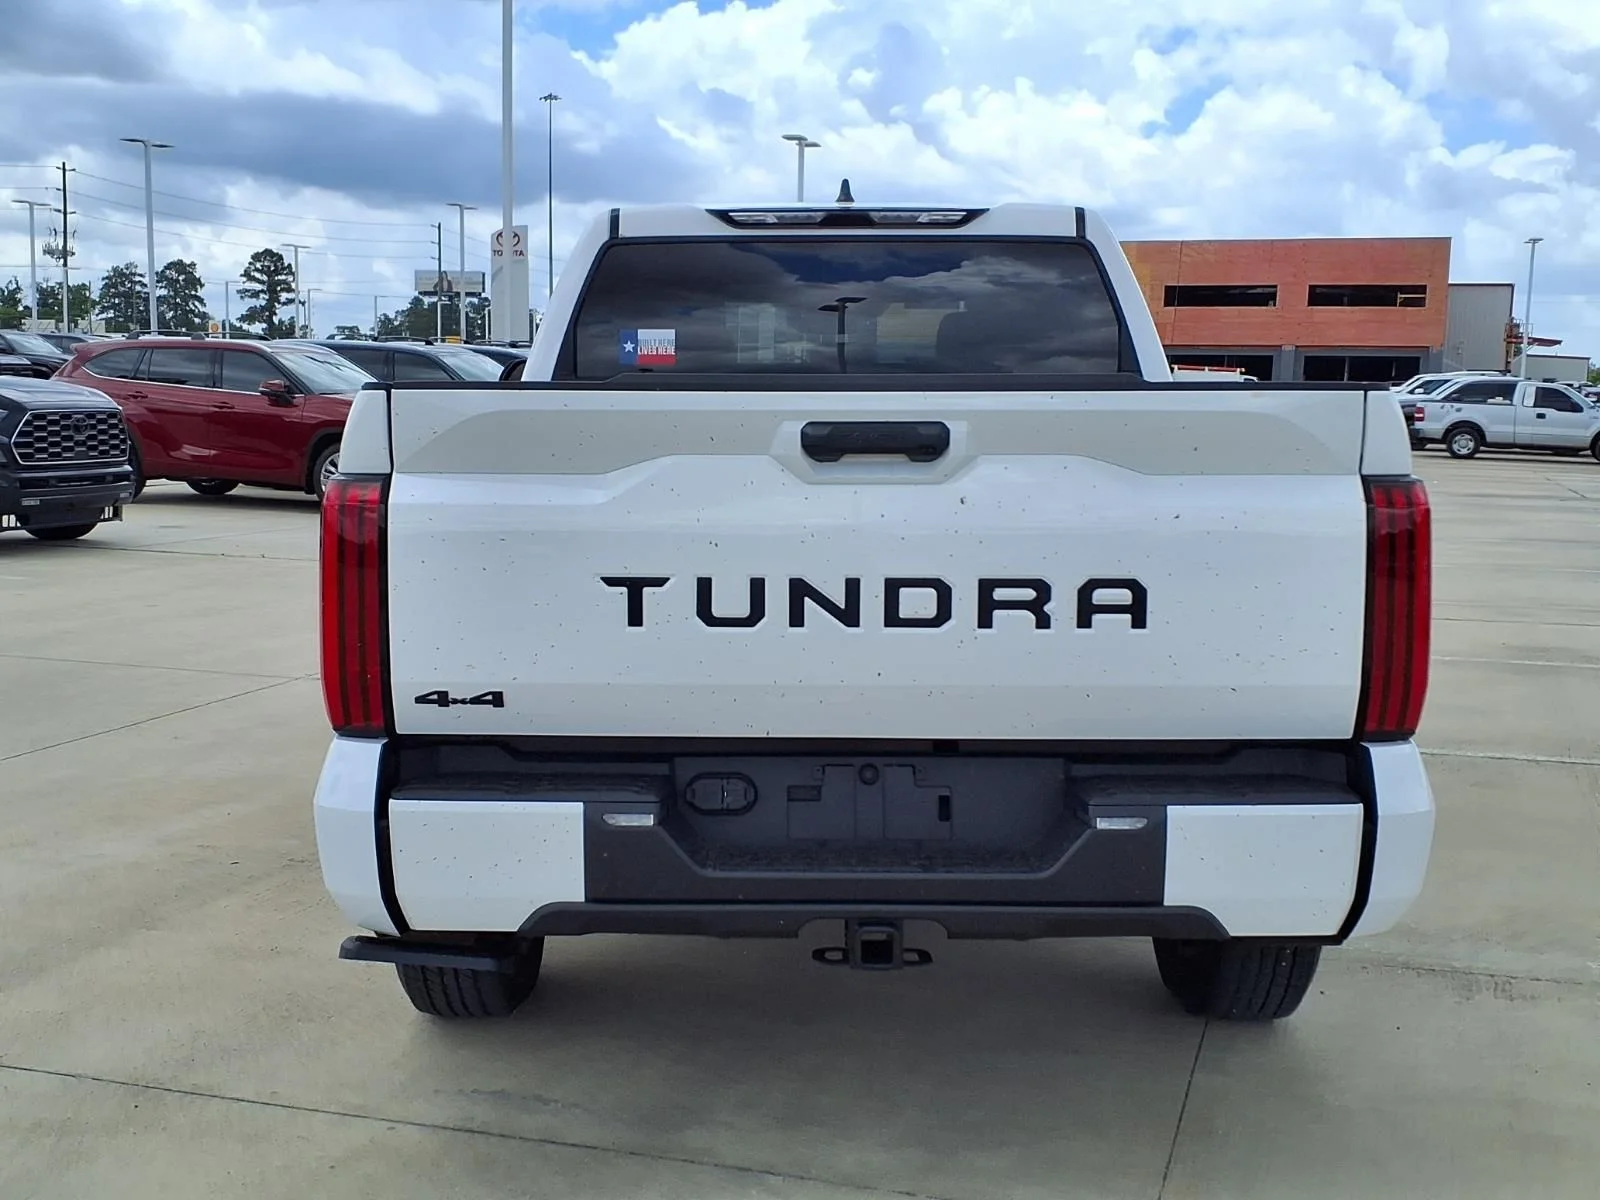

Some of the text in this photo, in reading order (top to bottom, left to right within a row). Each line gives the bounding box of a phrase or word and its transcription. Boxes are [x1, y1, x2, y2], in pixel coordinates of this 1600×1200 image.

[493, 249, 525, 257] TOTA
[658, 338, 675, 346] HERE
[638, 346, 675, 355] LIVES HERE
[600, 576, 1148, 630] TUNDRA
